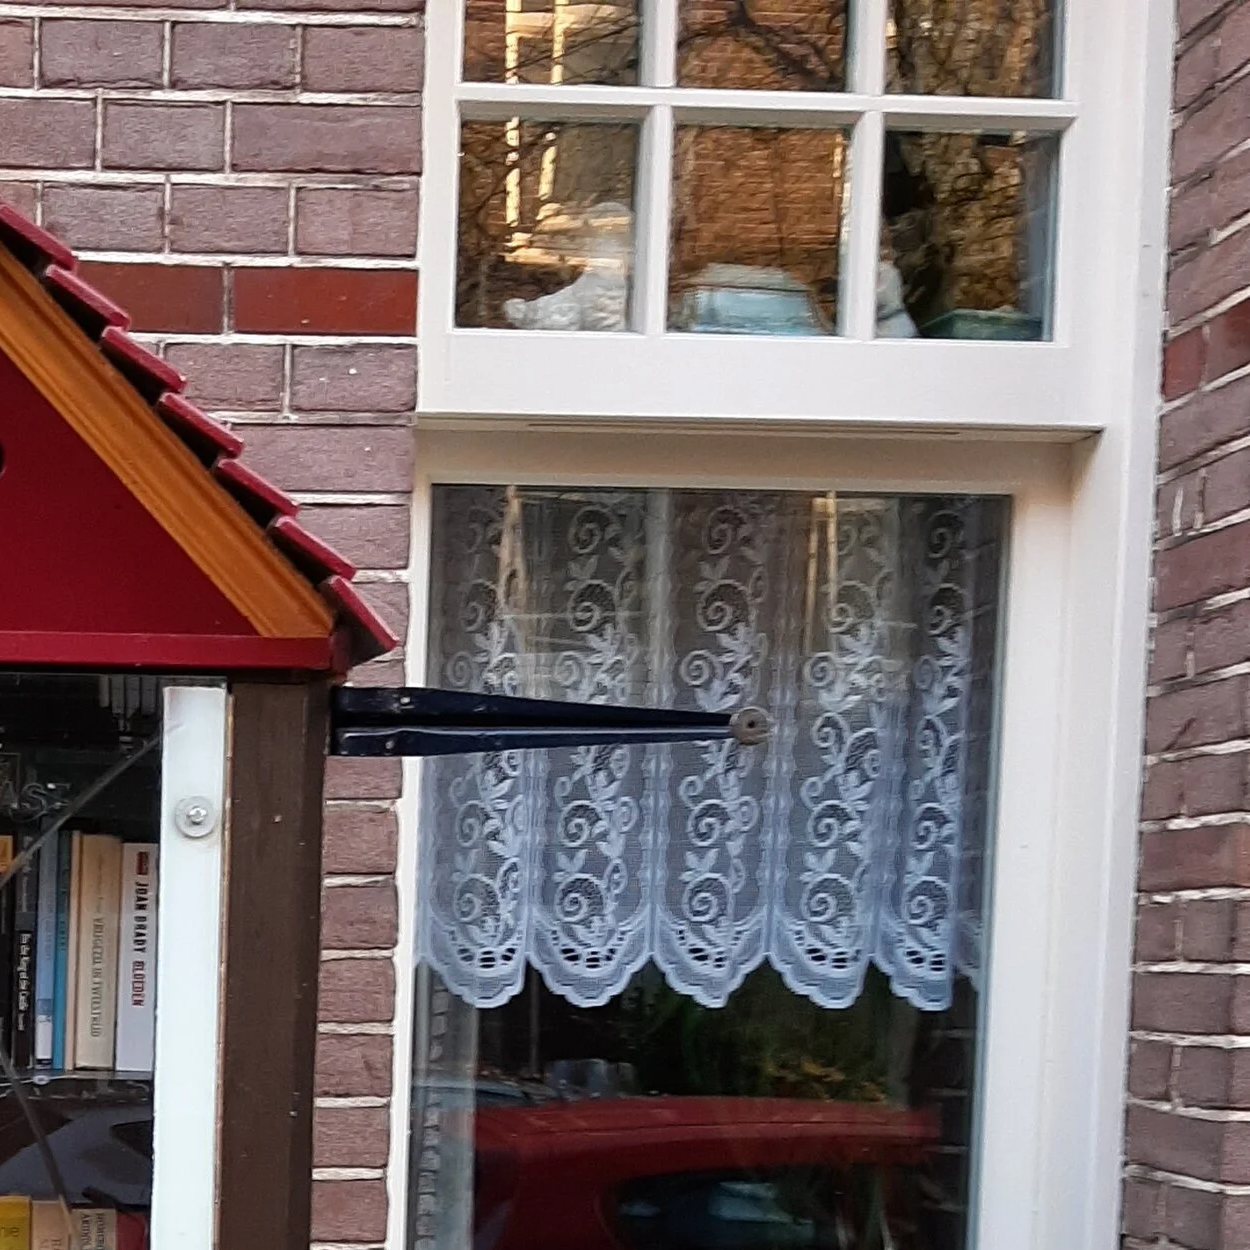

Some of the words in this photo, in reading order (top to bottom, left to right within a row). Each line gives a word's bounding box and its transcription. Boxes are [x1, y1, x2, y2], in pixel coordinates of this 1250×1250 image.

[134, 881, 148, 911] JOAN
[132, 915, 148, 954] BRADY
[131, 960, 145, 1008] BLOEDEN
